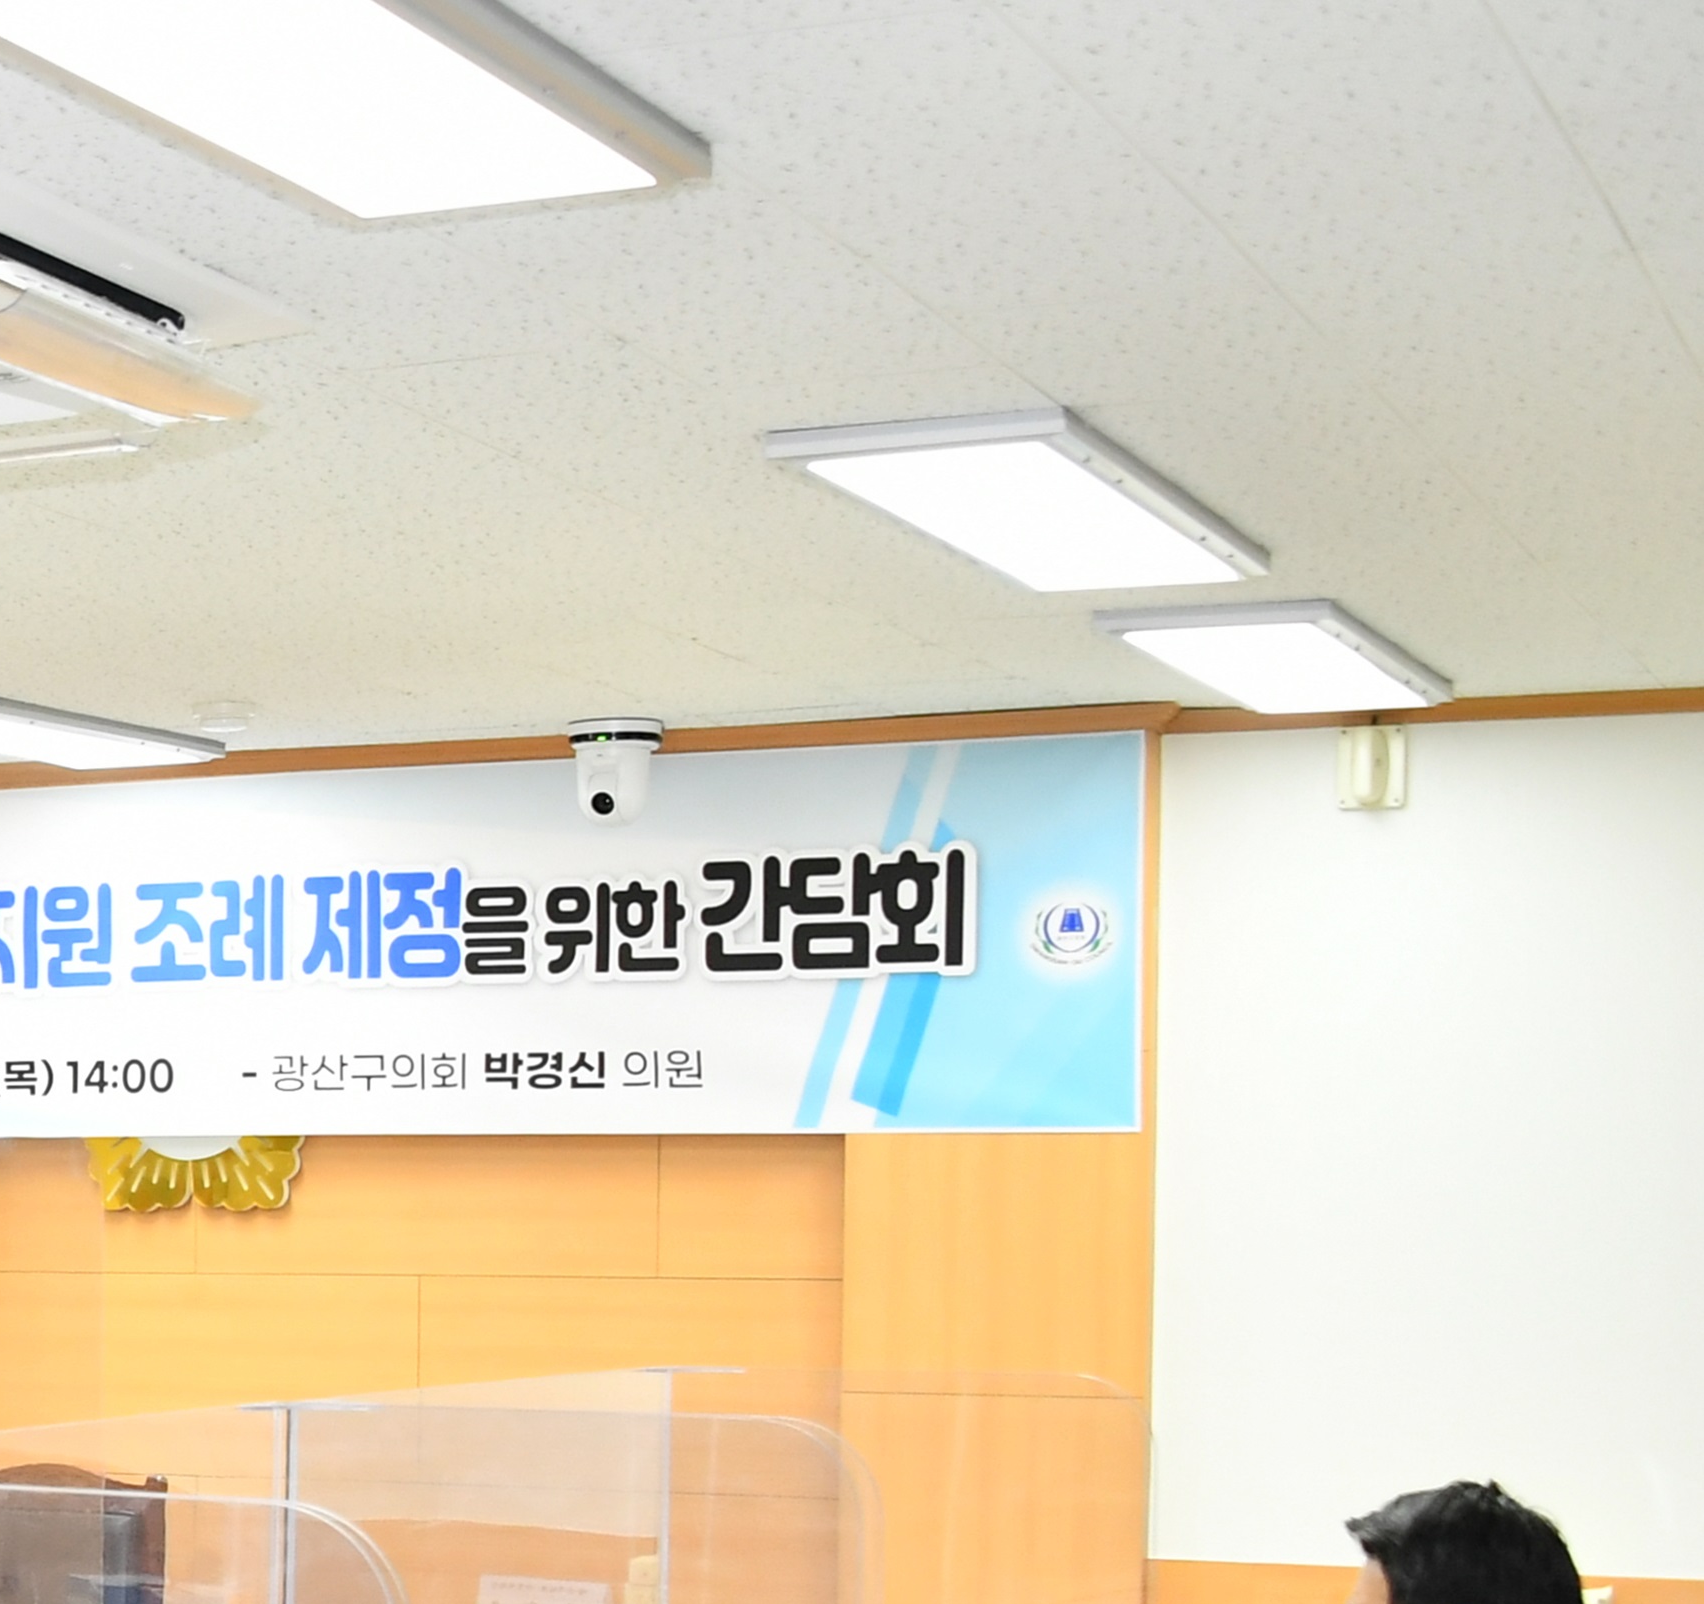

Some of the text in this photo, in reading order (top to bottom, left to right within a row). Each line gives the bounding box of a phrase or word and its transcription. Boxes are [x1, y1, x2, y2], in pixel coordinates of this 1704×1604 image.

[130, 873, 285, 983] 조례
[302, 867, 530, 980] 제정을
[544, 880, 686, 975] 위한
[700, 848, 965, 970] 간담회
[67, 1057, 175, 1095] 14:00
[271, 1053, 468, 1092] 광산구의회
[484, 1050, 607, 1090] 박경신
[622, 1049, 705, 1090] 의원
